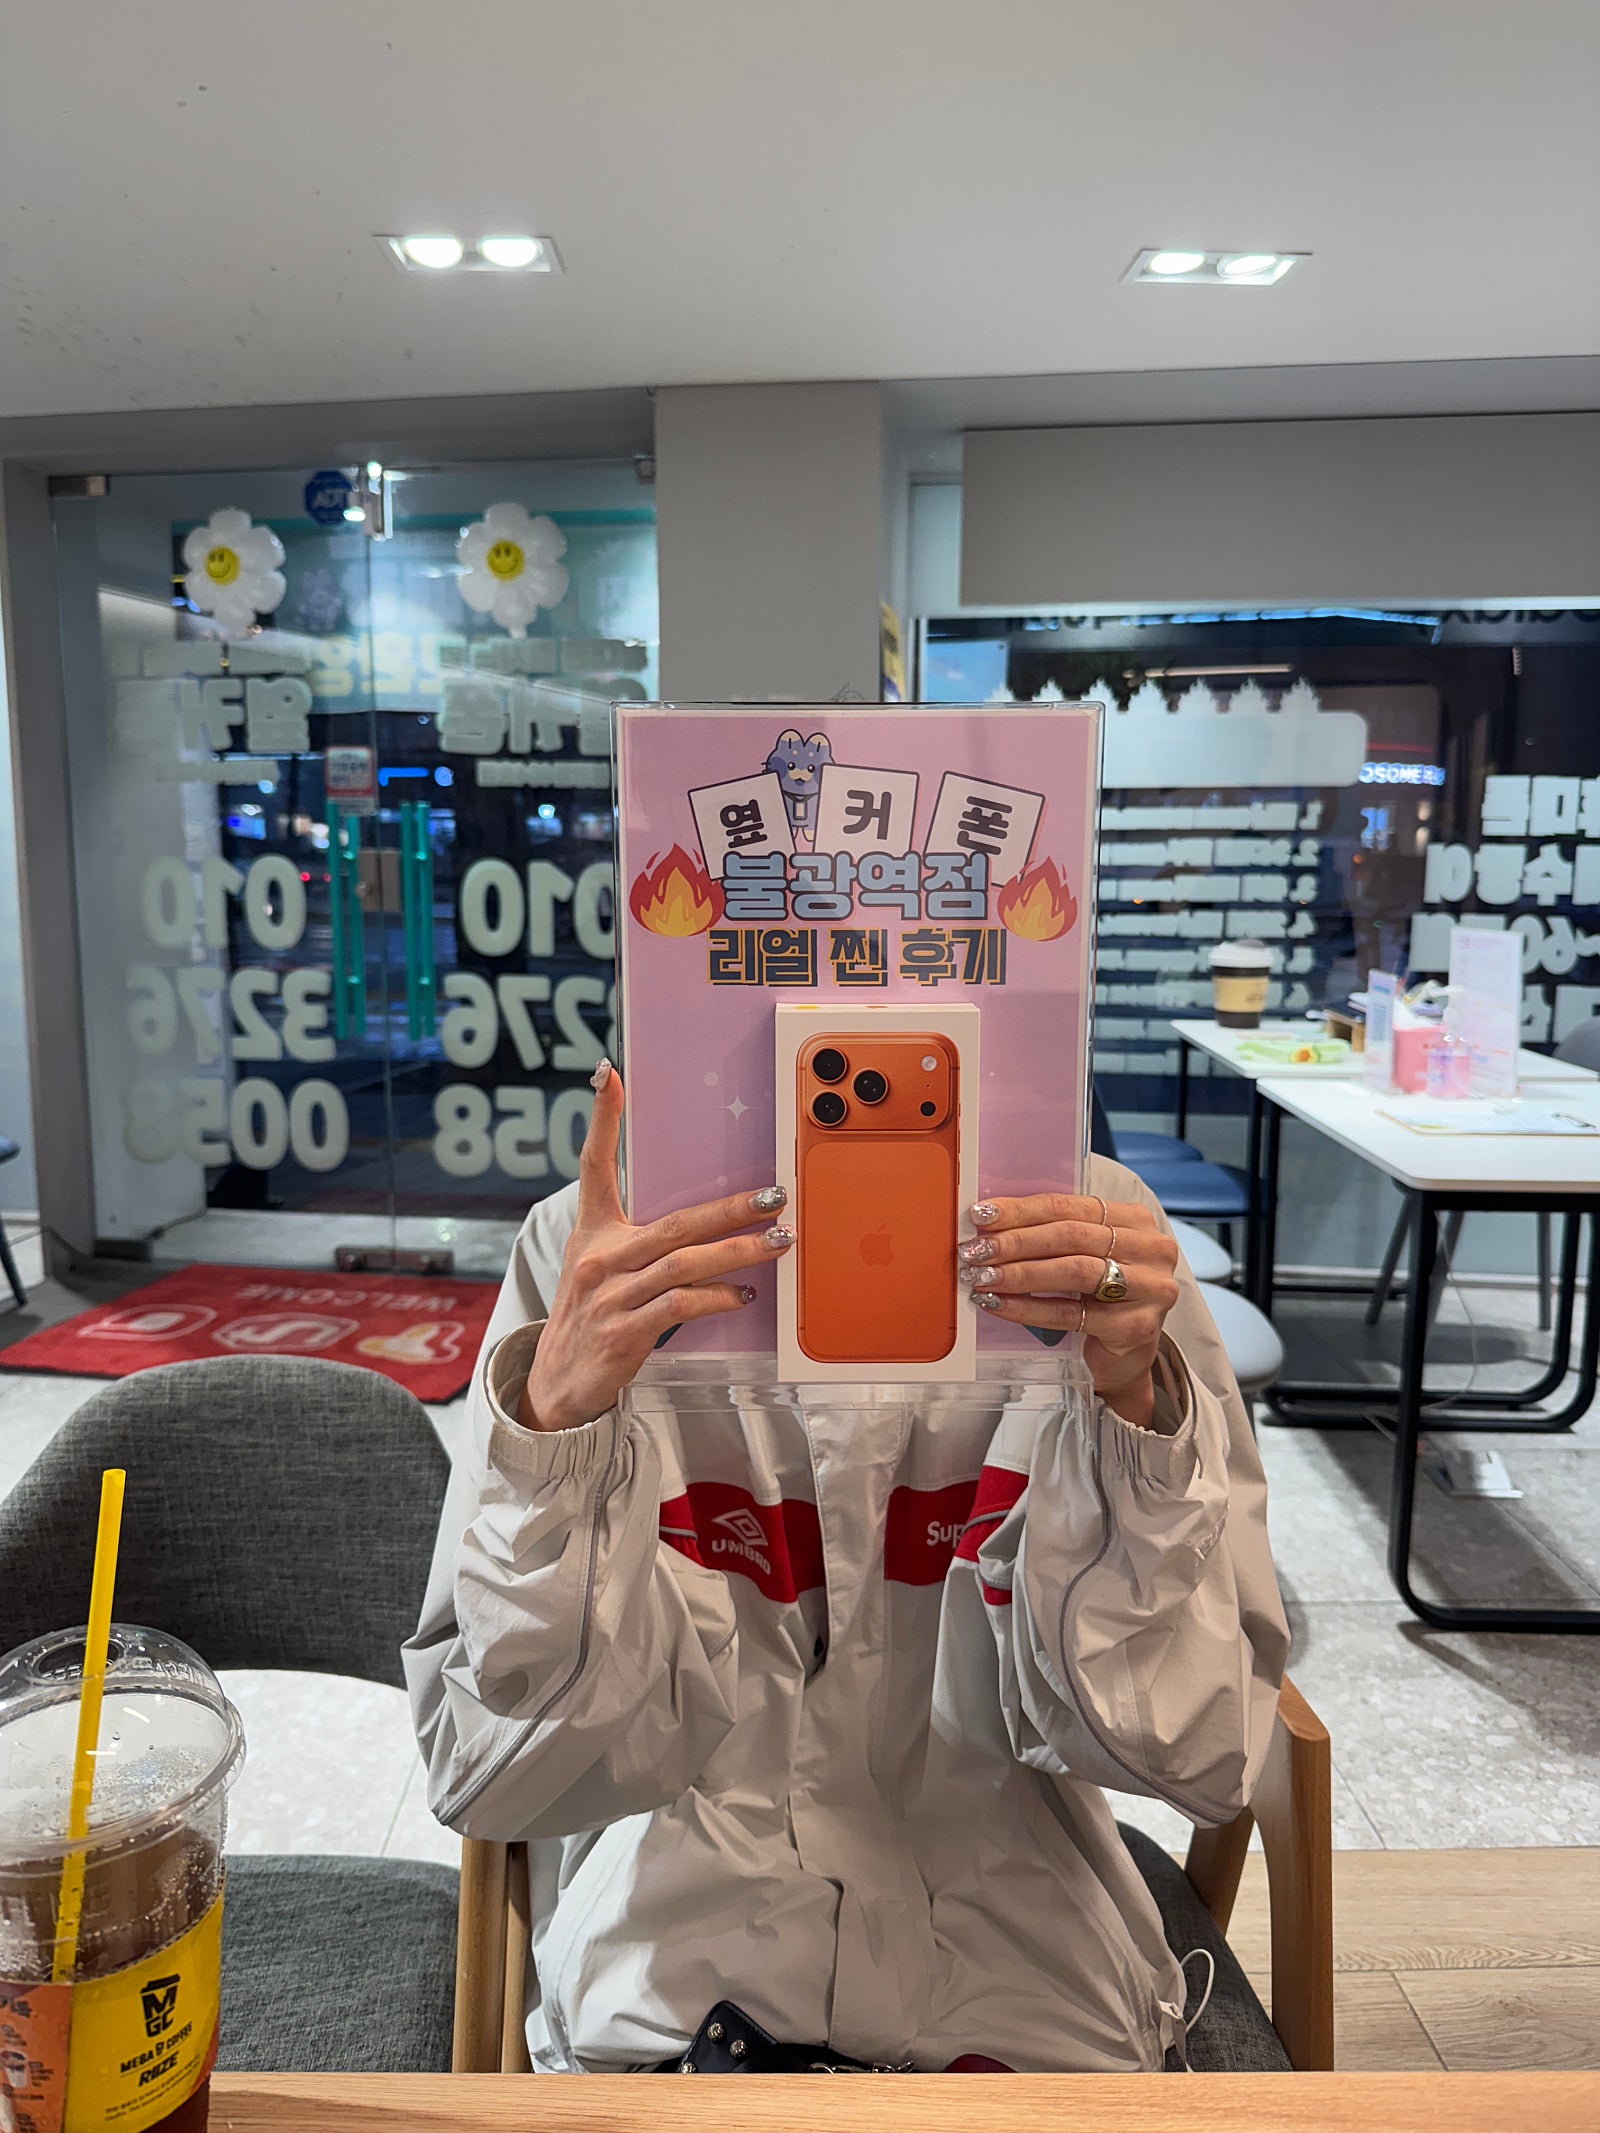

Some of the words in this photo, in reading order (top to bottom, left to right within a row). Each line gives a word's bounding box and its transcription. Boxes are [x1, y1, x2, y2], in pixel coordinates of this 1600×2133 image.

[719, 799, 767, 849] 옆
[844, 789, 892, 841] 커
[957, 795, 1012, 855] 폰
[721, 850, 991, 922] 불광역점
[707, 928, 817, 987] 리얼
[828, 928, 888, 987] 찐
[900, 926, 1006, 986] 후기
[711, 1538, 771, 1576] UMBRO
